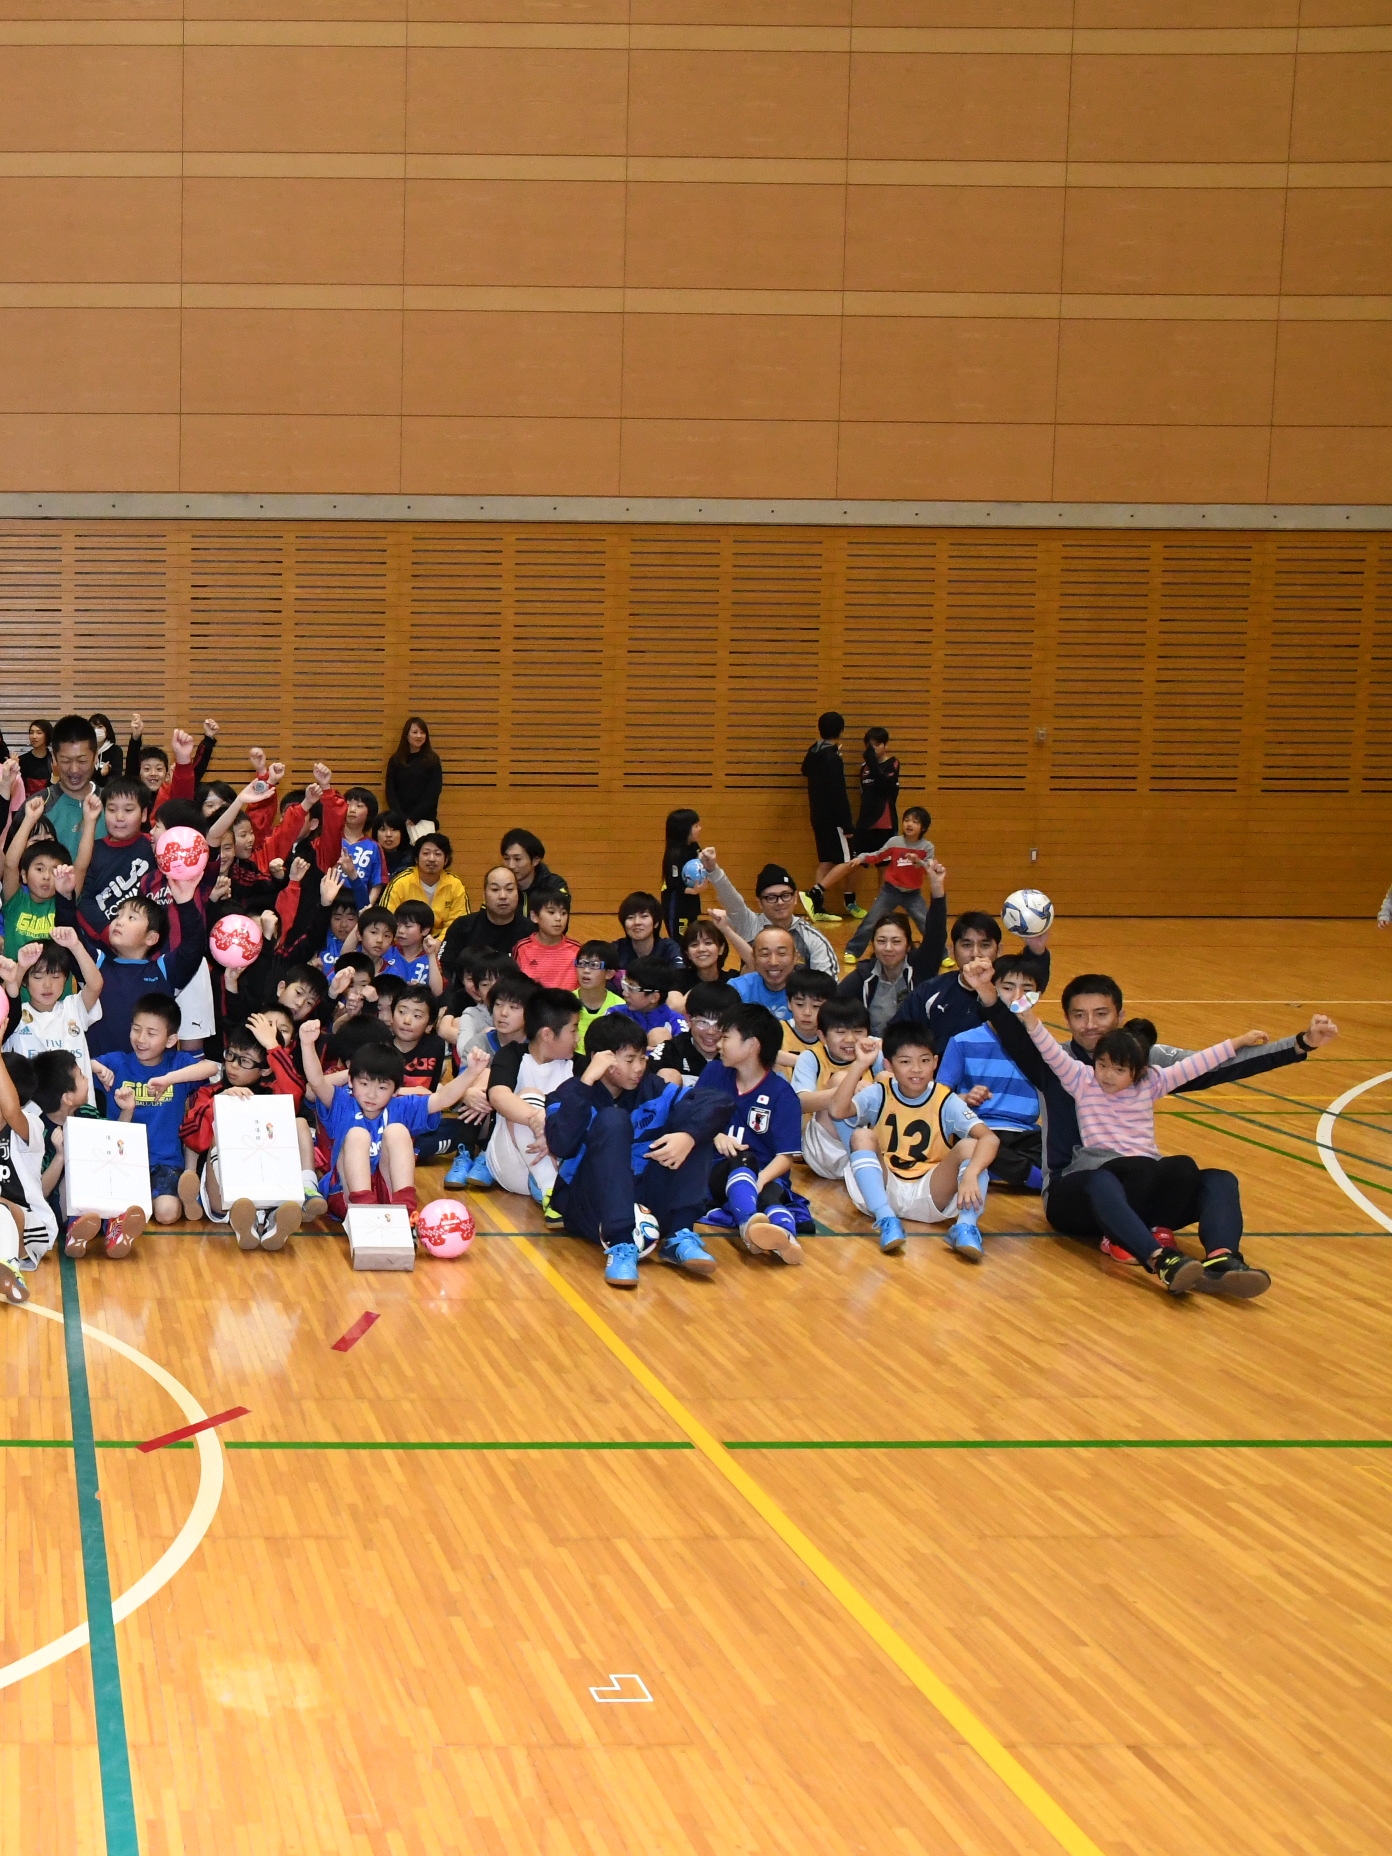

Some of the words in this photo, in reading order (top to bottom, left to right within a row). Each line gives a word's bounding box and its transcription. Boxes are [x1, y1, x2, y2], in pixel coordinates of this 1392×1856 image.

[353, 846, 374, 868] 36
[95, 858, 150, 911] FILA
[45, 1039, 62, 1049] Fly
